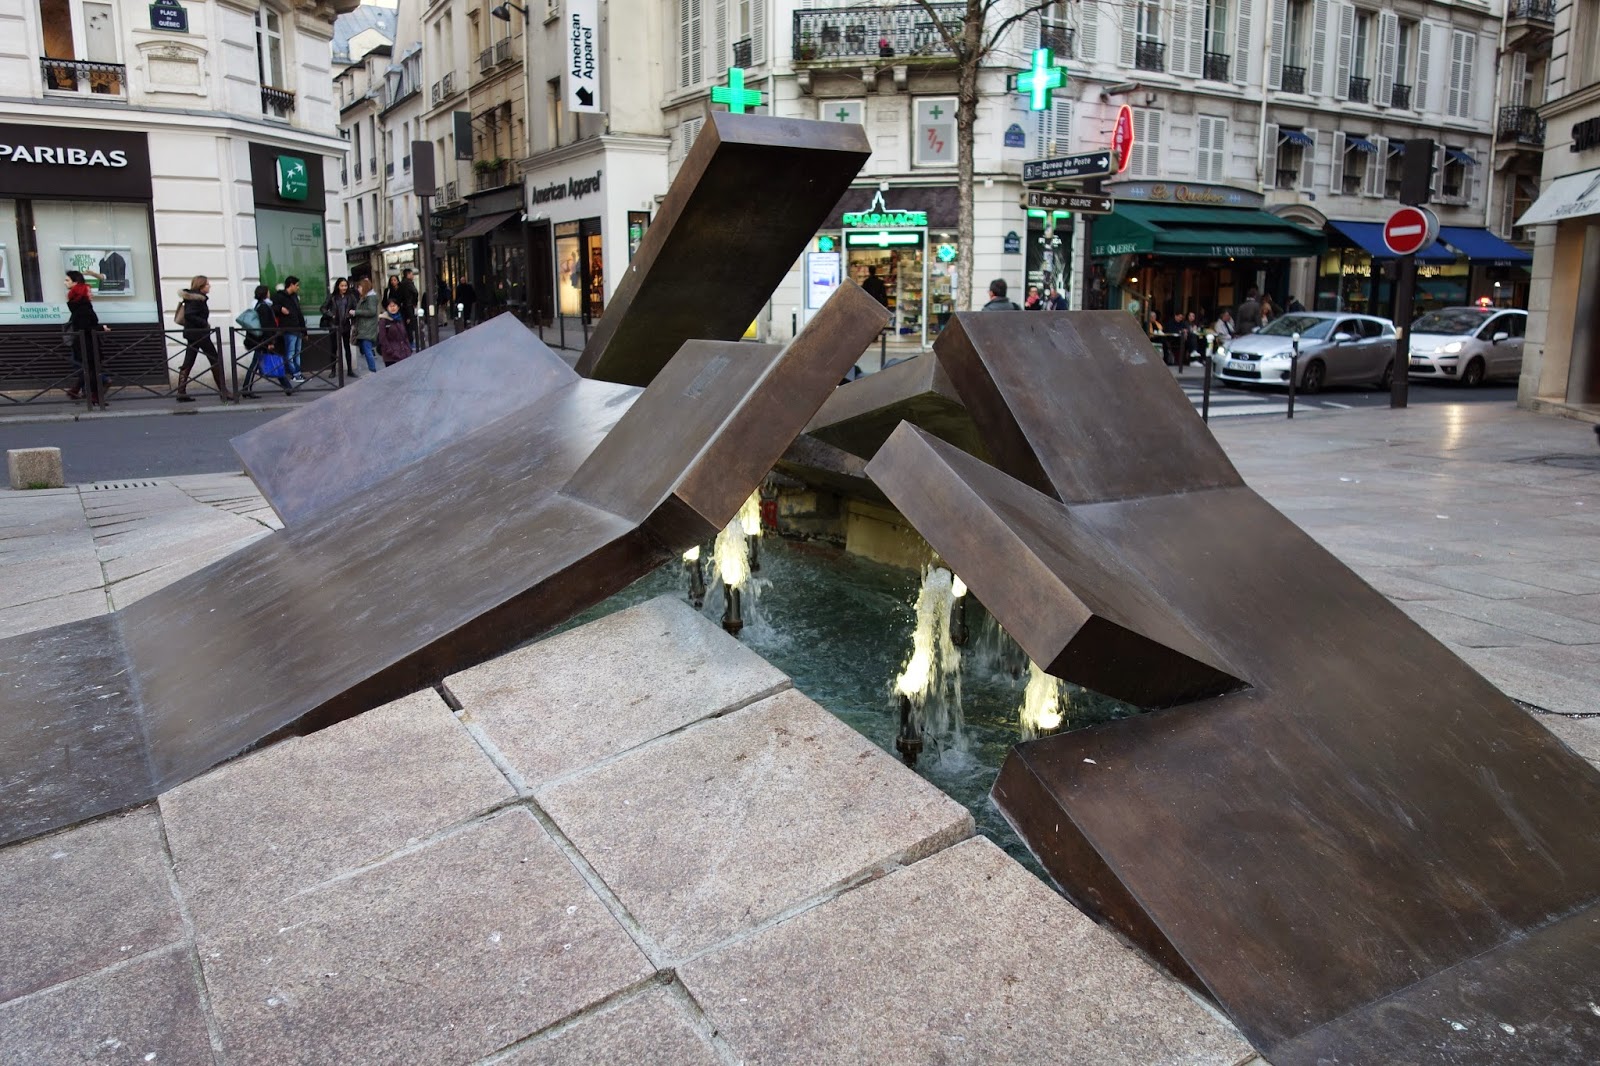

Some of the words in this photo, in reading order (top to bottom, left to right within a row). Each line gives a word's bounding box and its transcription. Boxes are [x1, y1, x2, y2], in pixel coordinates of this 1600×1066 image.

[571, 13, 581, 78] American
[582, 27, 594, 79] Apparel
[928, 128, 944, 153] 7/7
[0, 144, 128, 167] PARIBAS
[1042, 161, 1063, 170] Bureau
[1073, 158, 1091, 166] Poste
[532, 182, 566, 206] American
[568, 171, 601, 200] Apparel
[1070, 198, 1092, 207] SULPICE
[843, 213, 928, 226] PHARMACIE
[1107, 243, 1137, 254] QUEBEC
[1211, 246, 1222, 256] LE
[1224, 246, 1256, 256] QUEBEC
[20, 306, 48, 314] banque
